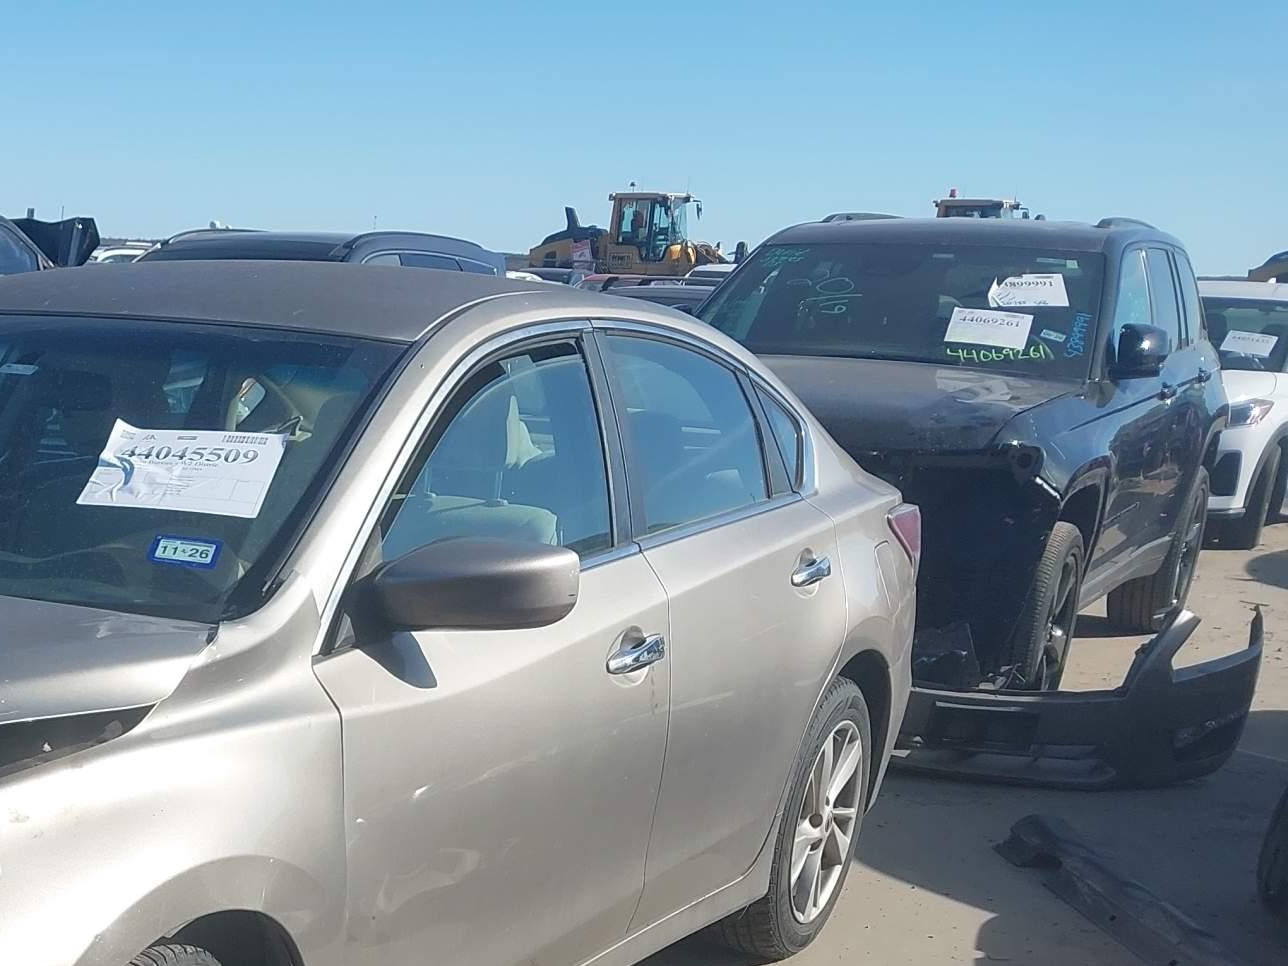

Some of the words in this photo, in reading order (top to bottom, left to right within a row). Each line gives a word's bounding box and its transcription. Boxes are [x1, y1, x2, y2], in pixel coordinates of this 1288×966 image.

[959, 314, 1021, 328] 44069261
[946, 343, 1046, 363] 44069261
[121, 445, 260, 465] 44045509
